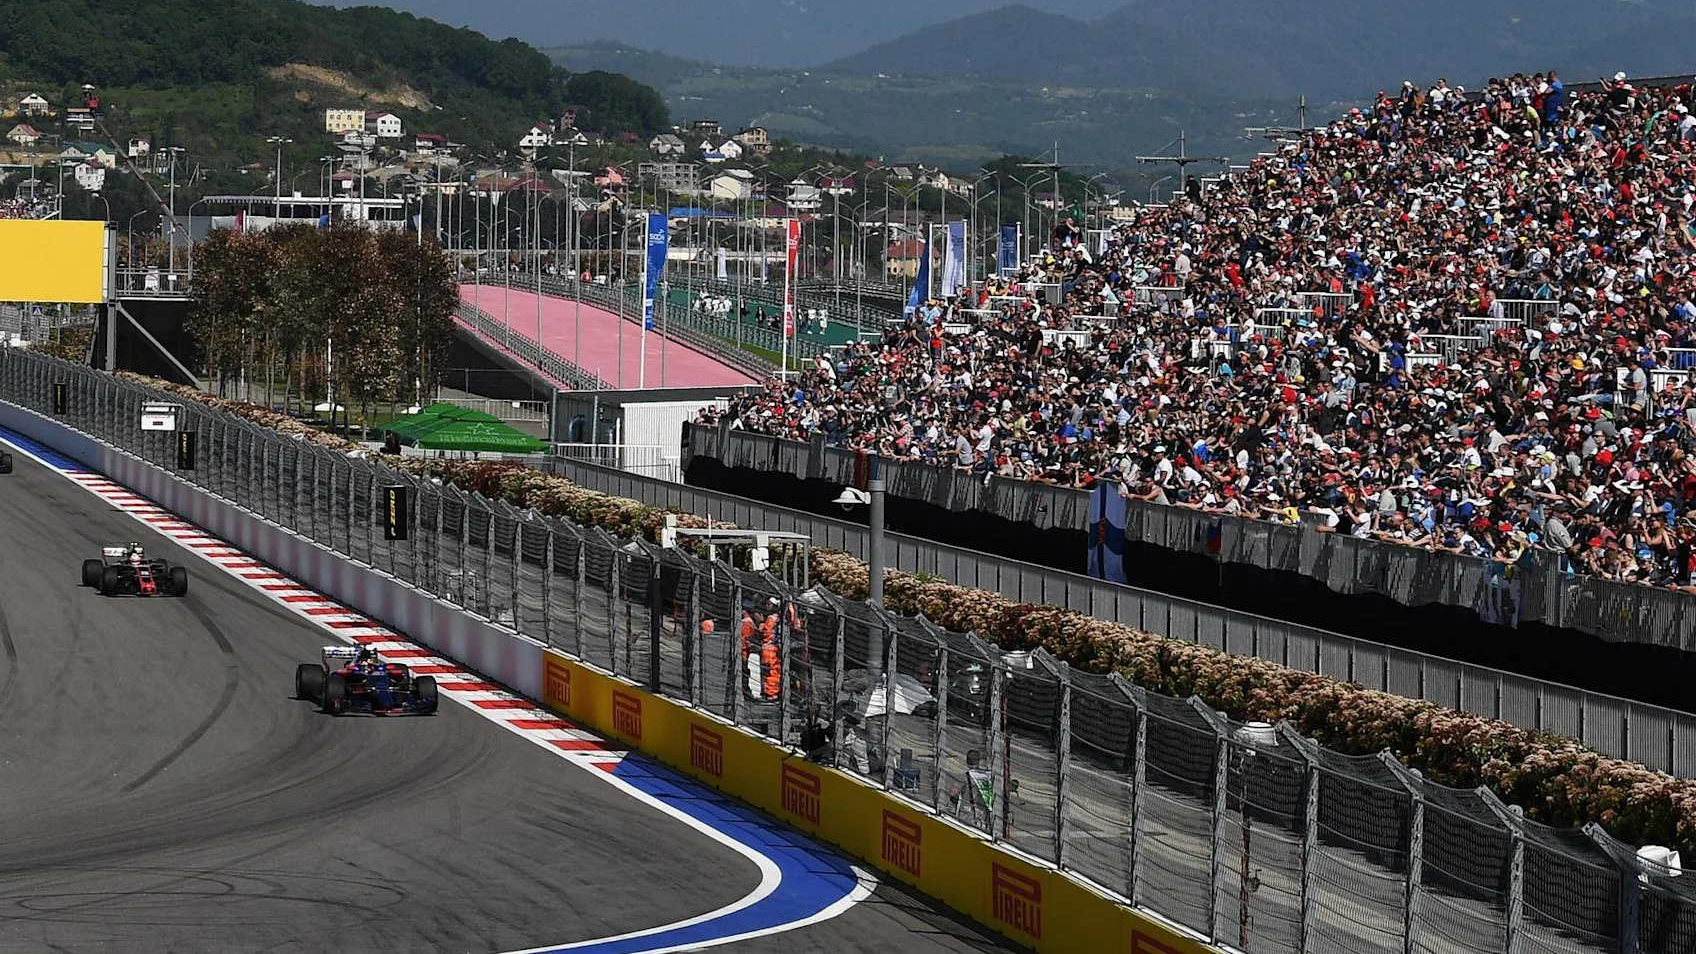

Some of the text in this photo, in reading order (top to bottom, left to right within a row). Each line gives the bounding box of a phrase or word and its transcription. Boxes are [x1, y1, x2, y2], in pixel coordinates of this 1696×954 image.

[547, 660, 571, 706] PIRELLI
[612, 689, 642, 740] PIRELLI
[690, 722, 723, 779] PIRELLI
[782, 763, 821, 825] PIRELLI
[883, 809, 922, 879] PIRELLI
[992, 861, 1042, 940] PIRELLI
